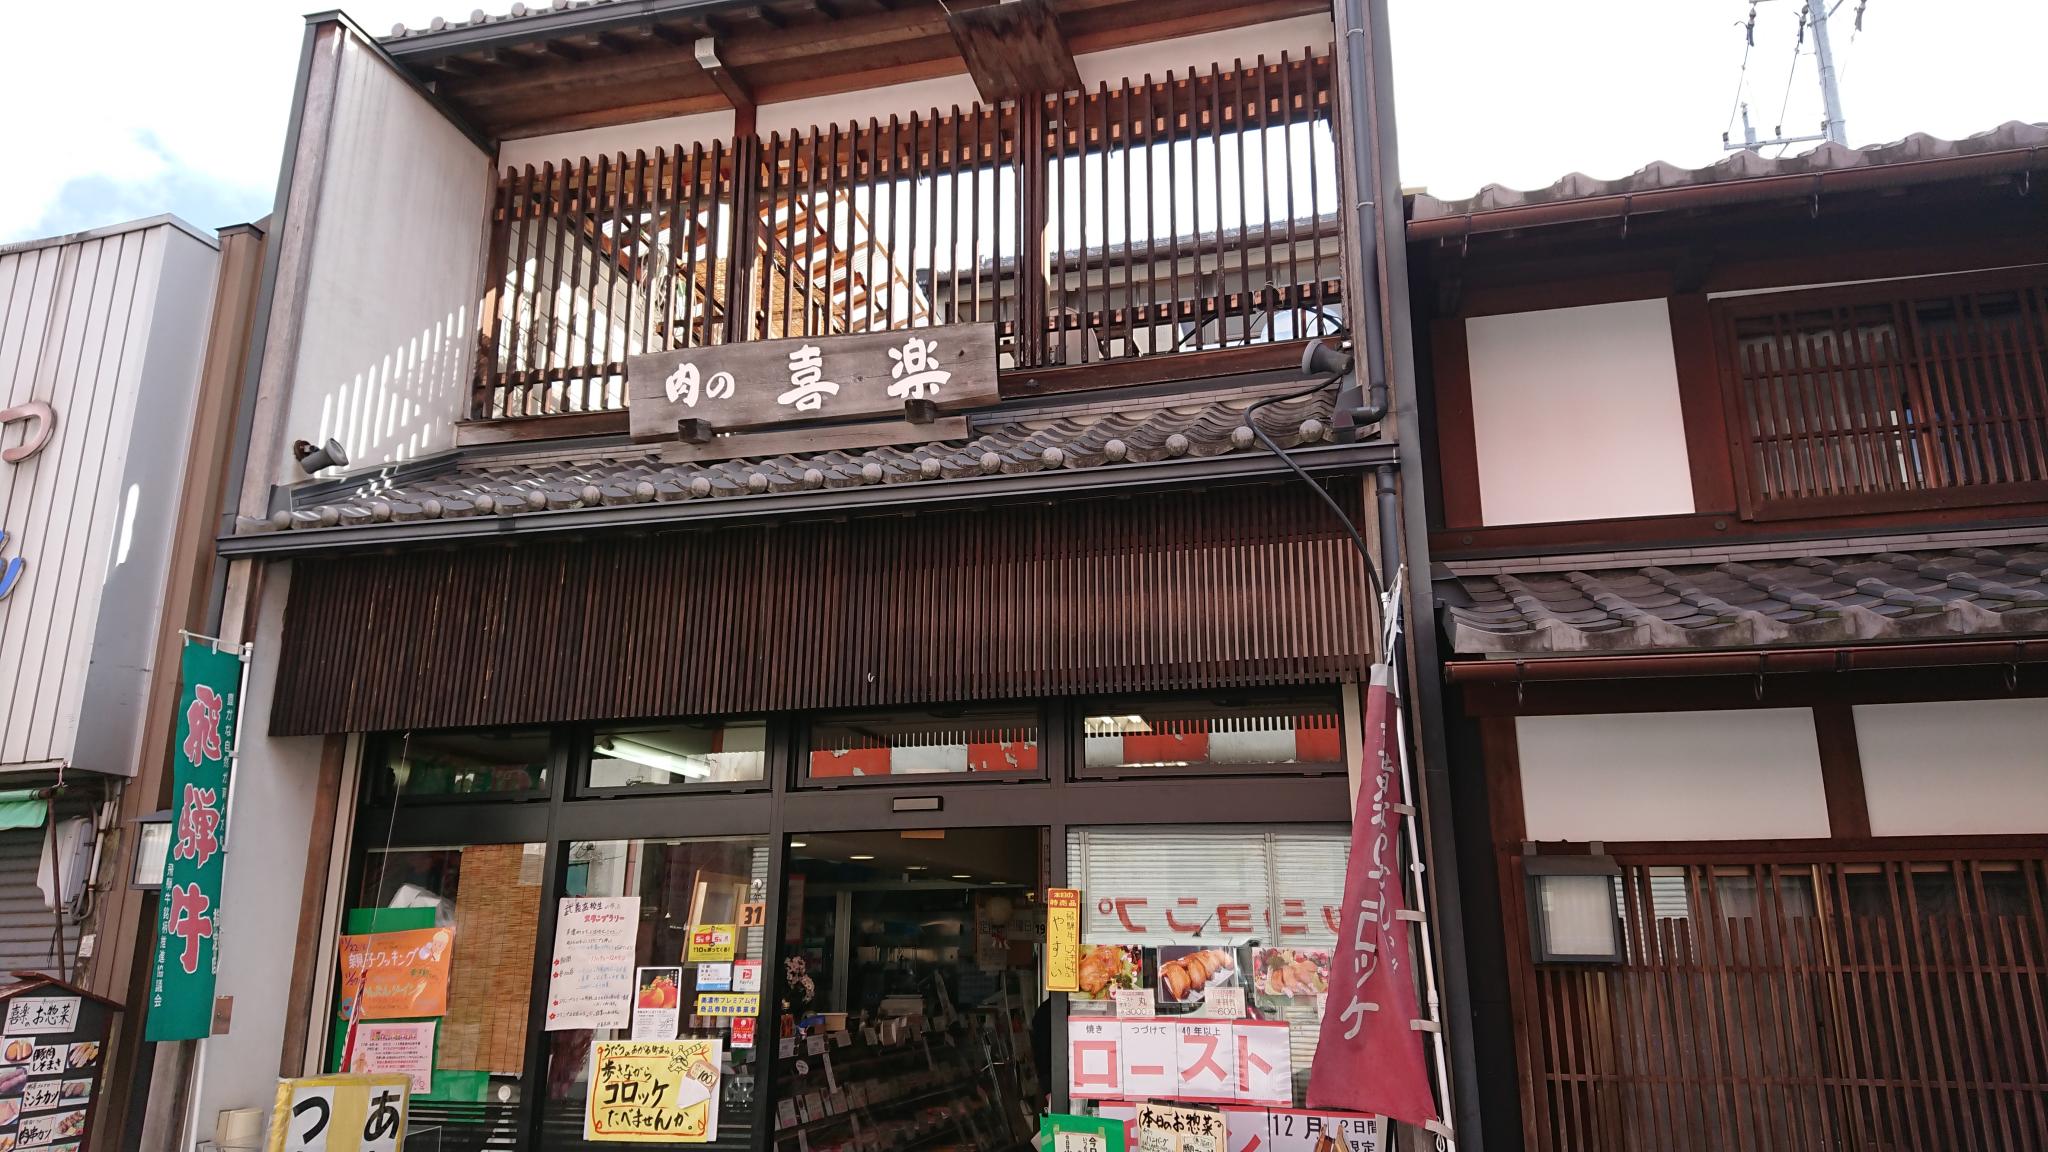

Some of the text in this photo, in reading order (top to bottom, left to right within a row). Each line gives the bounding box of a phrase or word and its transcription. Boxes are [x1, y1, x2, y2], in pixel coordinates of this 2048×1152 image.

[168, 683, 223, 974] 飛騨牛
[583, 914, 625, 923] スタンプラリー
[743, 906, 763, 925] 31
[348, 946, 420, 969] 親子クッキング
[701, 996, 758, 1004] 美濃市プレミアム付
[1085, 1024, 1221, 1037] 焼き つづけて 40年以上
[32, 1057, 62, 1072] しそまき
[602, 1060, 652, 1083] 歩きながら
[1073, 1035, 1273, 1092] ロースト
[24, 1090, 59, 1107] ミンチカツ
[603, 1078, 670, 1109] コロッケ
